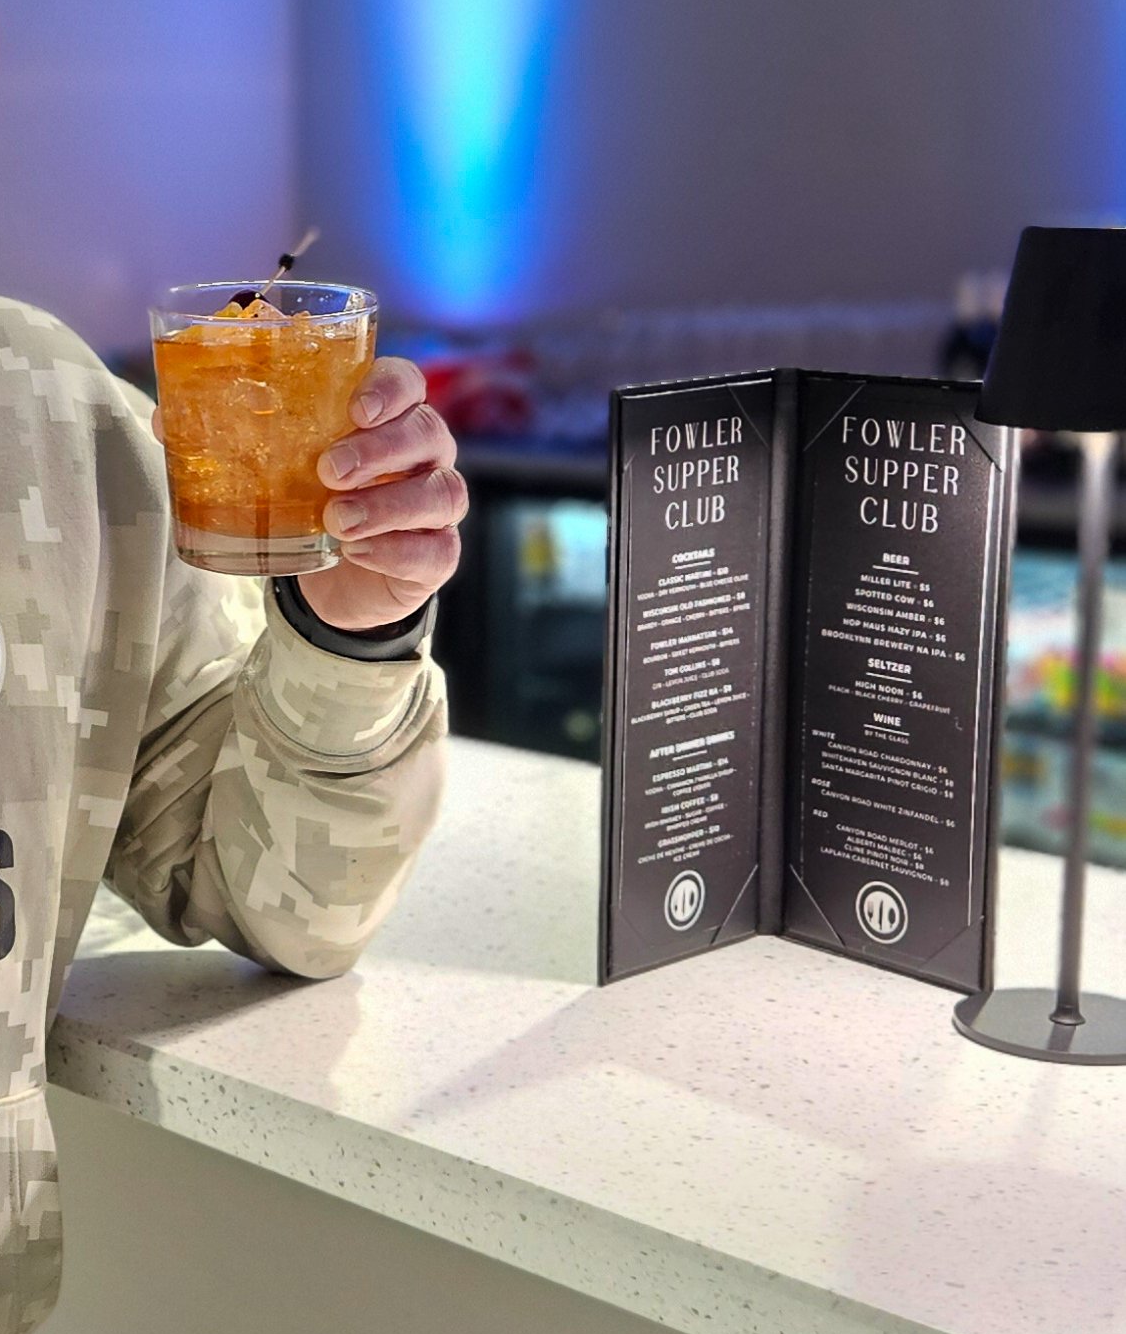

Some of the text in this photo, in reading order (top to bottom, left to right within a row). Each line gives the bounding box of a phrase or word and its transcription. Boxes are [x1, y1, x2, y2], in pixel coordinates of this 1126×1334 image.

[651, 416, 742, 455] FOWLER
[843, 416, 966, 455] FOWLER
[653, 455, 739, 493] SUPPER
[845, 455, 959, 495] SUPPER
[665, 495, 725, 530] CLUB
[860, 497, 938, 533] CLUB
[882, 553, 910, 565] BEER
[860, 574, 890, 585] MILLER
[893, 580, 911, 589] LITE
[855, 589, 934, 608] SPOTTED COW $6
[846, 603, 945, 626] WISCONSIN AMBER $6
[912, 628, 927, 639] IPA
[936, 634, 946, 642] $6
[874, 638, 914, 651] BREWERY
[916, 646, 929, 655] NA
[931, 648, 946, 658] IPA
[955, 652, 966, 661] $6
[868, 658, 912, 674] SELTZER
[878, 685, 904, 696] NOON
[873, 712, 901, 726] WINE
[813, 809, 828, 818] RED
